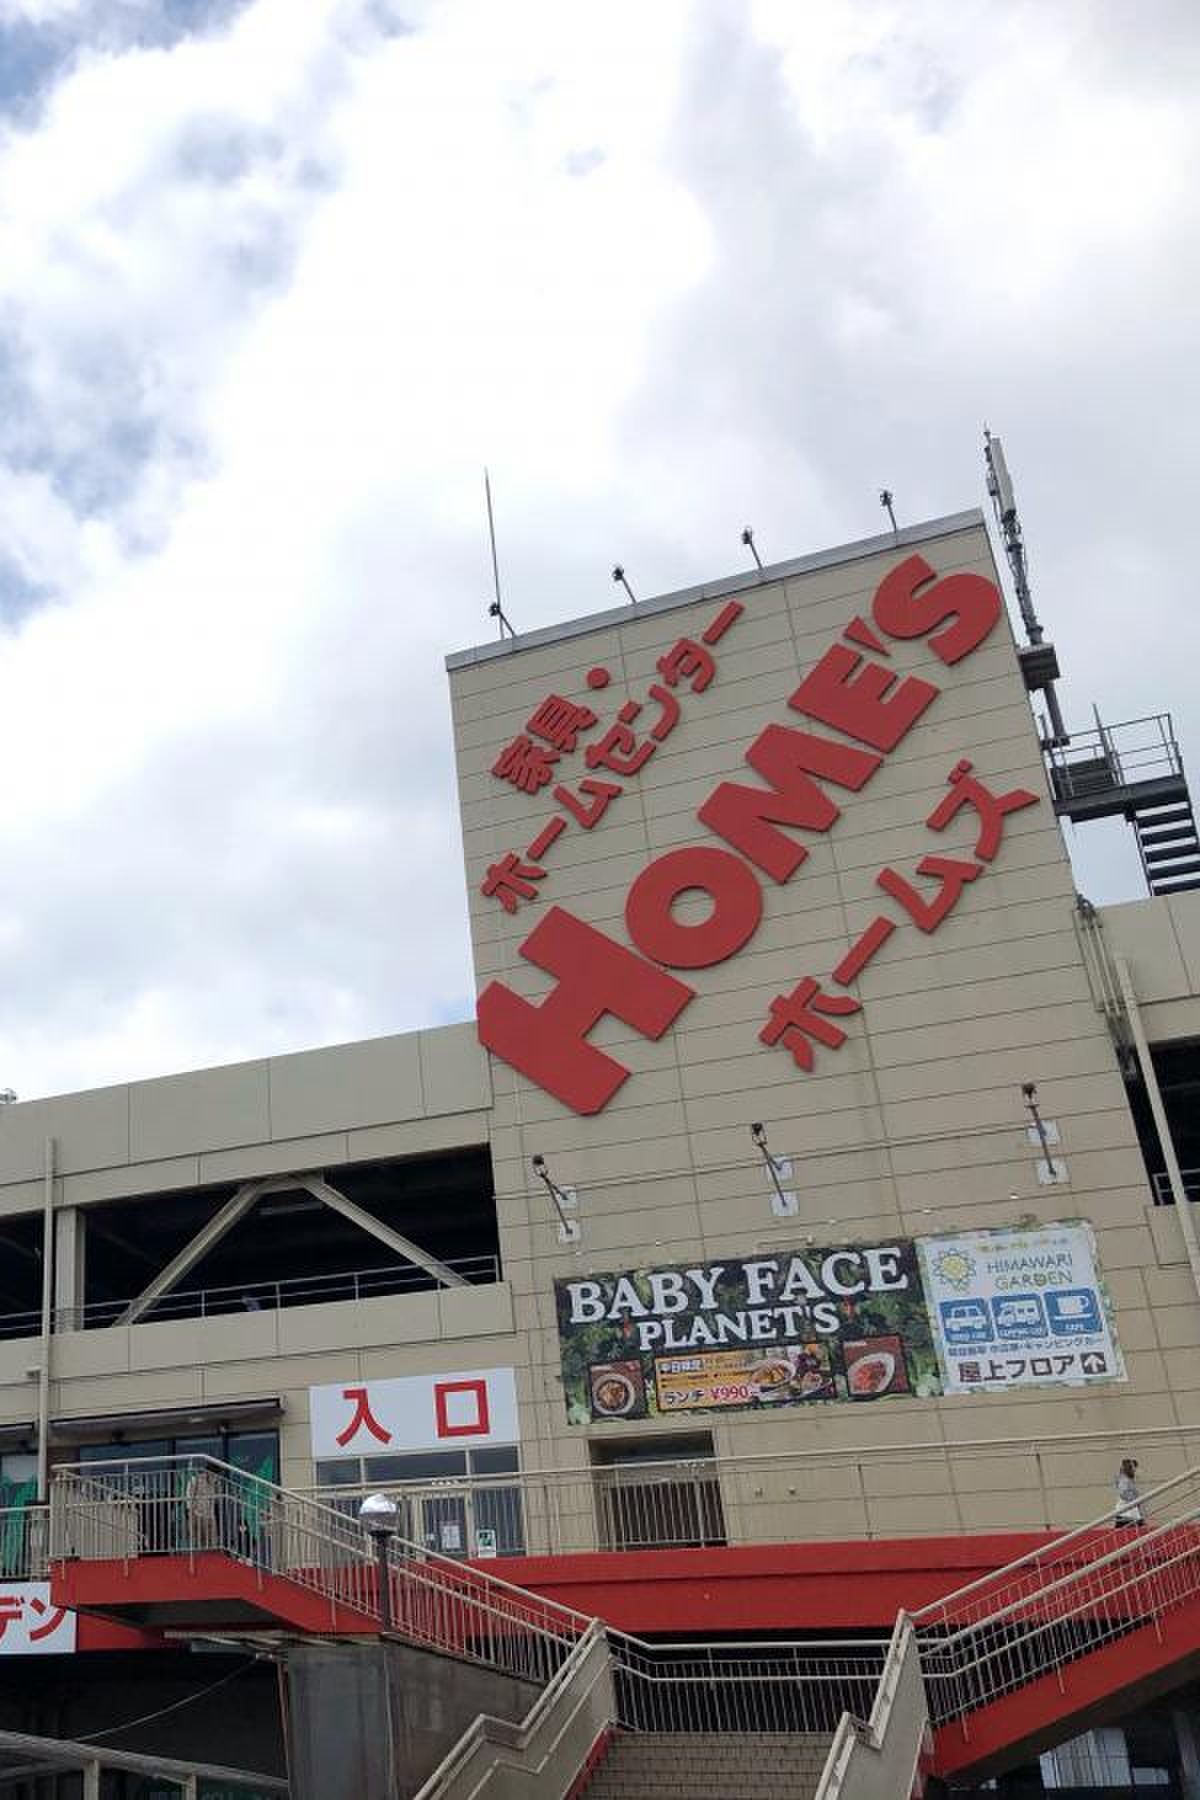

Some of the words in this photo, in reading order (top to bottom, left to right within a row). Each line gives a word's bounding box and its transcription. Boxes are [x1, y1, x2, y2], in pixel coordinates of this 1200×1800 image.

[481, 600, 744, 914] ホームセンター
[478, 553, 1001, 1116] HOME'S
[759, 759, 1040, 1072] ホームズ
[566, 1267, 724, 1324] BABY
[742, 1247, 908, 1304] FACE
[986, 1252, 1073, 1274] HIMAWARI
[994, 1271, 1073, 1290] GARDEN
[637, 1302, 840, 1350] PLANET'S
[959, 1355, 1075, 1383] 屋上フロア
[335, 1379, 490, 1447] 入口
